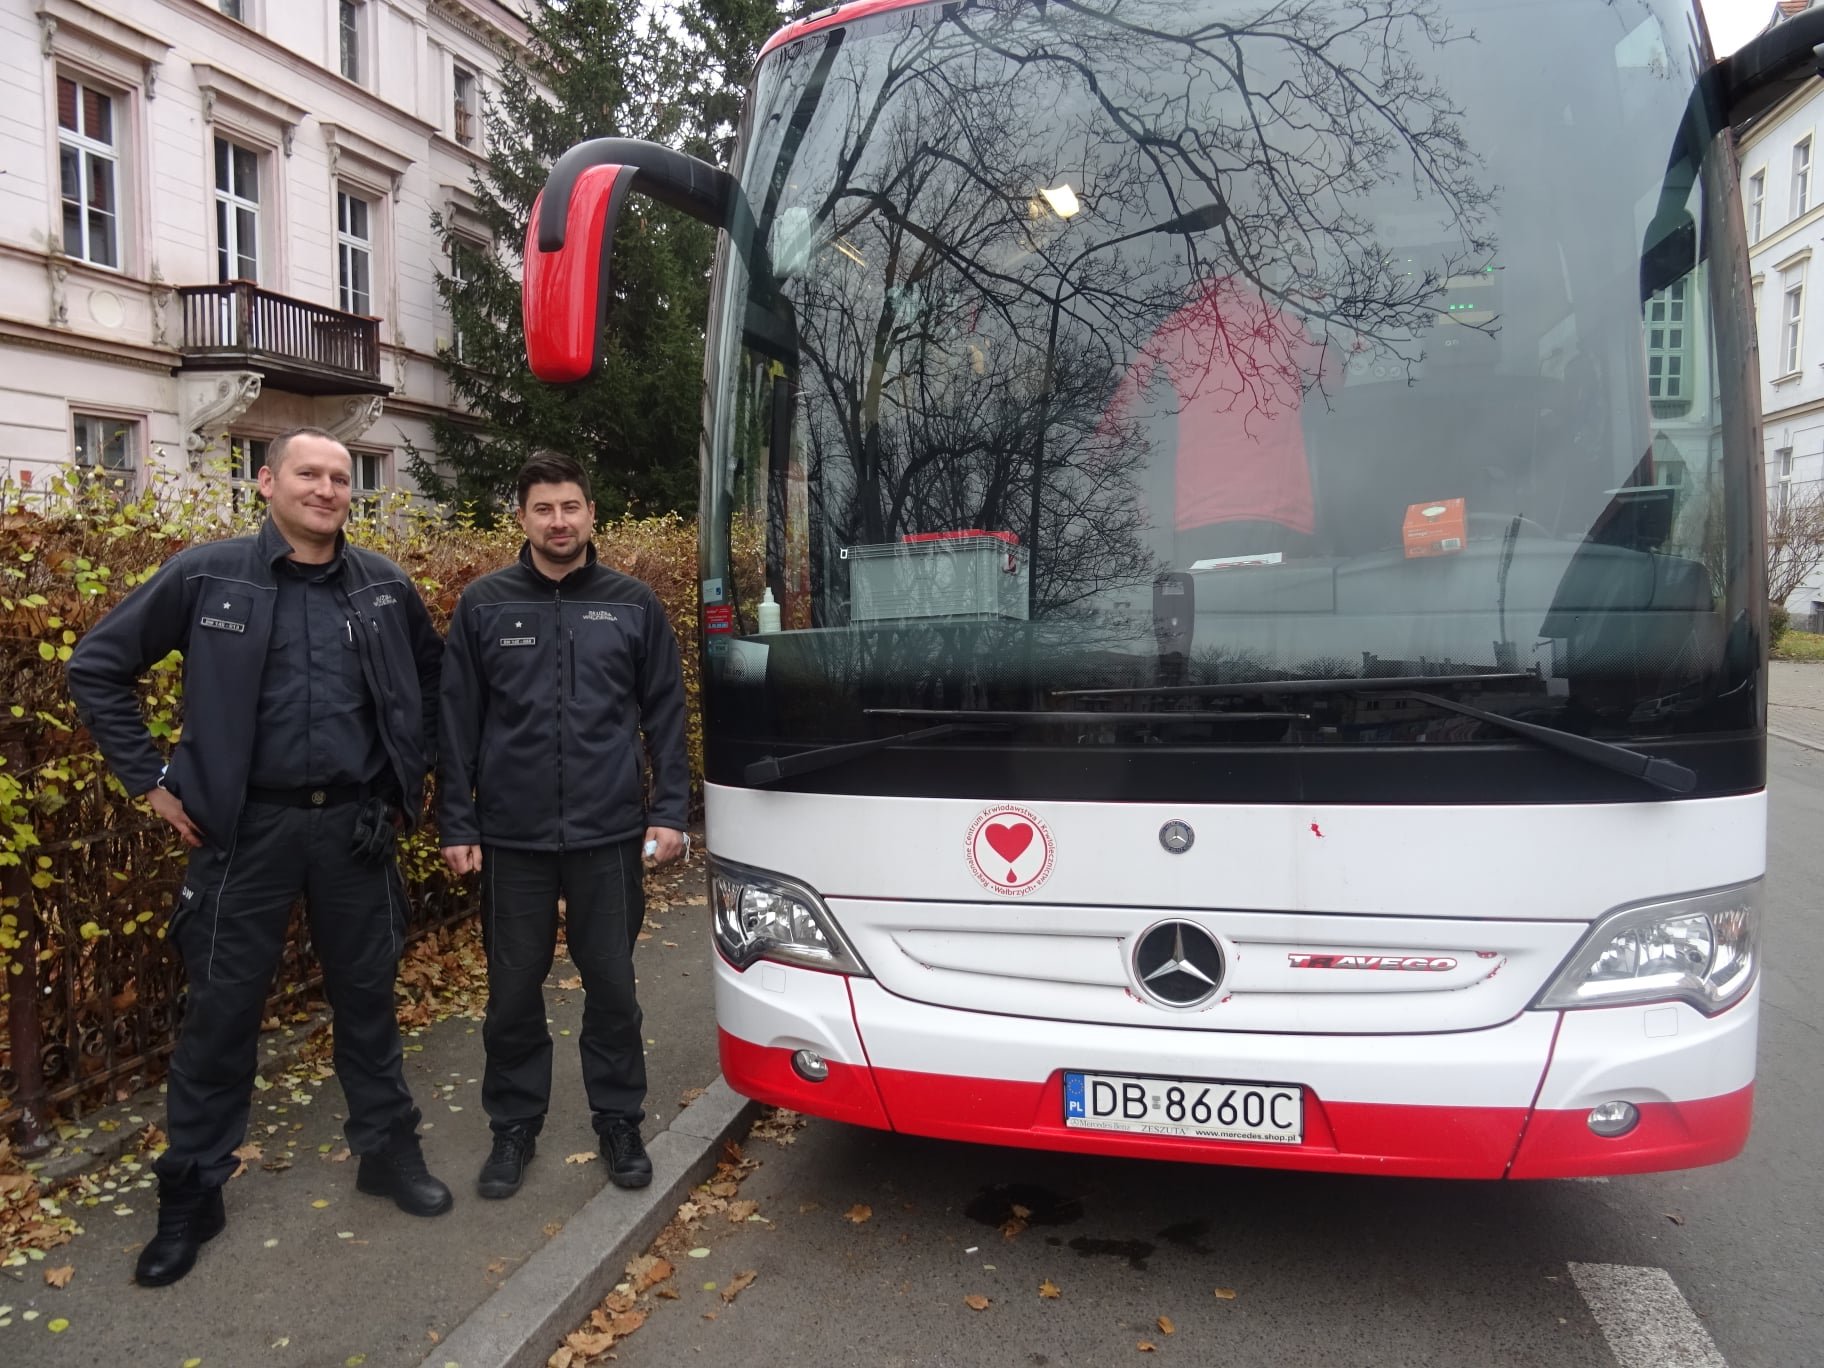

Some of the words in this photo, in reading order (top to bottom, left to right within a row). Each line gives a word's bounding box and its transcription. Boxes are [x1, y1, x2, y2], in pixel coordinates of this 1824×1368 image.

[983, 804, 1037, 821] Krwiodawstwa
[965, 815, 984, 846] Centrum
[965, 847, 989, 888] Regionalne
[182, 886, 194, 900] SW
[1288, 953, 1458, 971] TRAVEGO
[1069, 1101, 1084, 1112] PL
[1092, 1080, 1148, 1119] DB
[1166, 1086, 1293, 1129] 8660C
[1141, 1124, 1187, 1135] ZESZUTA
[1195, 1128, 1297, 1142] www.mercedes.shop.pl
